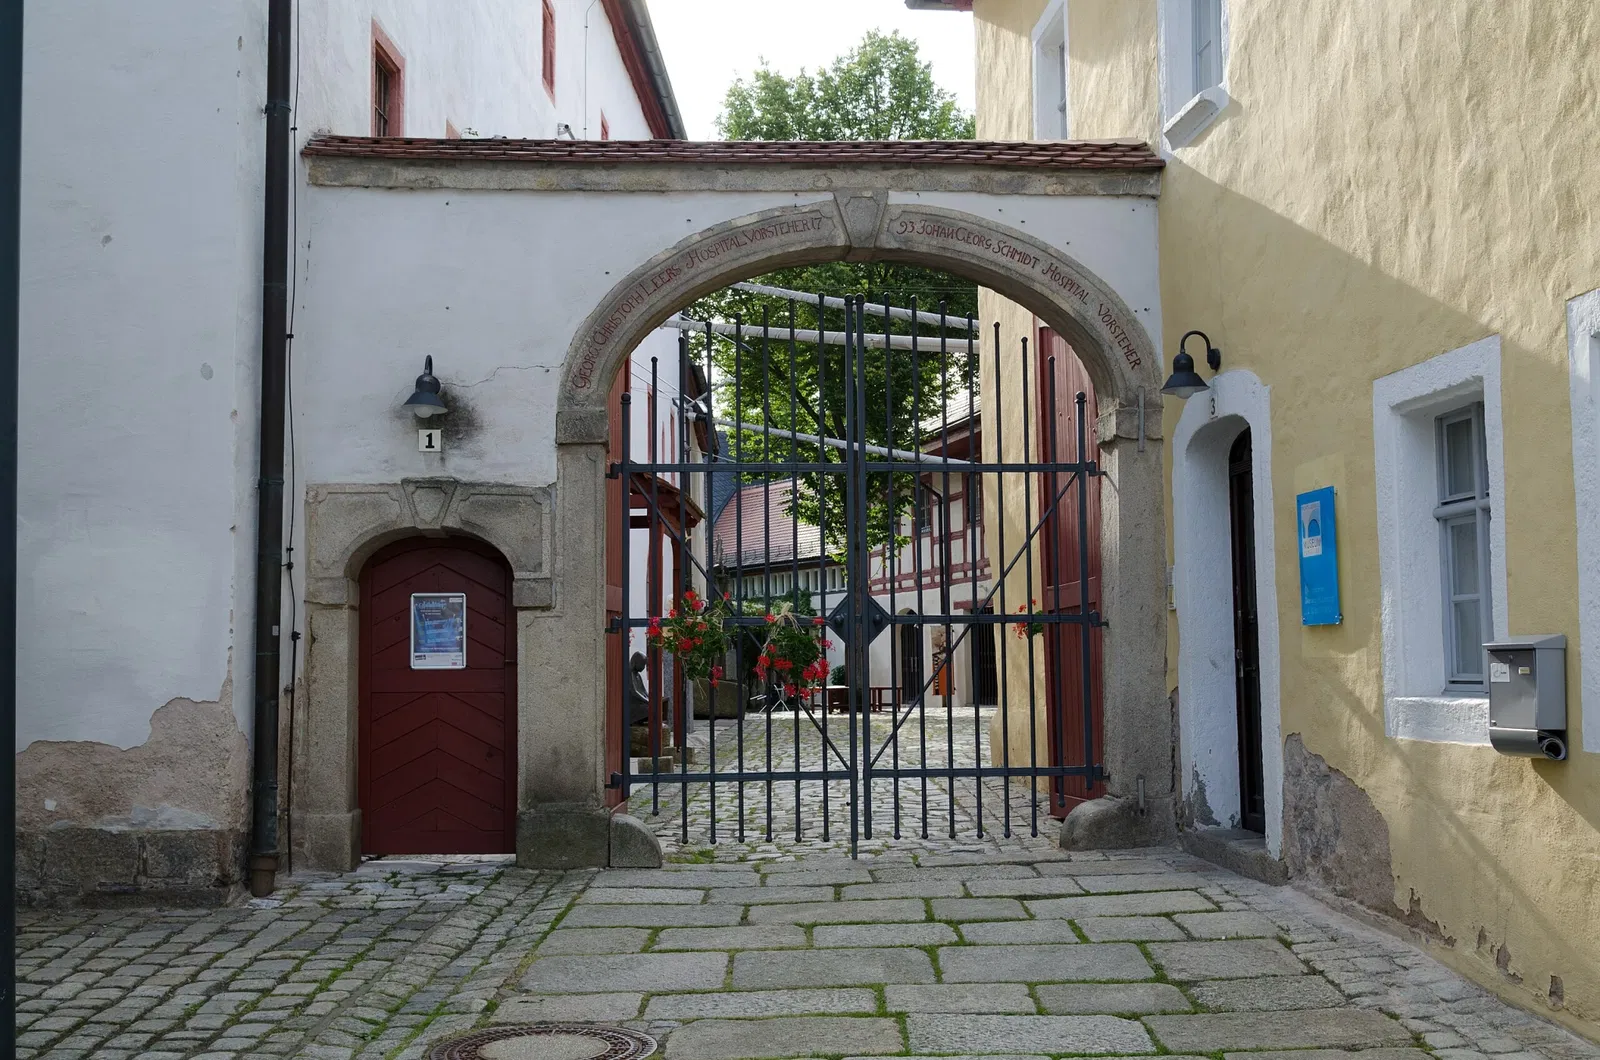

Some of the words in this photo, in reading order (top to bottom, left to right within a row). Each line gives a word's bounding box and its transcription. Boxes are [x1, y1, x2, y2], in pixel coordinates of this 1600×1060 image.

[593, 287, 645, 345] CHRISTOPH
[639, 264, 682, 297] LEERS
[686, 235, 746, 269] HOSPITAL
[742, 219, 810, 243] VORSTEHER
[955, 226, 993, 250] GEORG
[992, 239, 1040, 269] SCHMIDT
[1042, 262, 1090, 306] HOSPITAL
[1097, 303, 1142, 371] VORSTEHER
[425, 432, 435, 449] 1
[1210, 397, 1216, 416] 3
